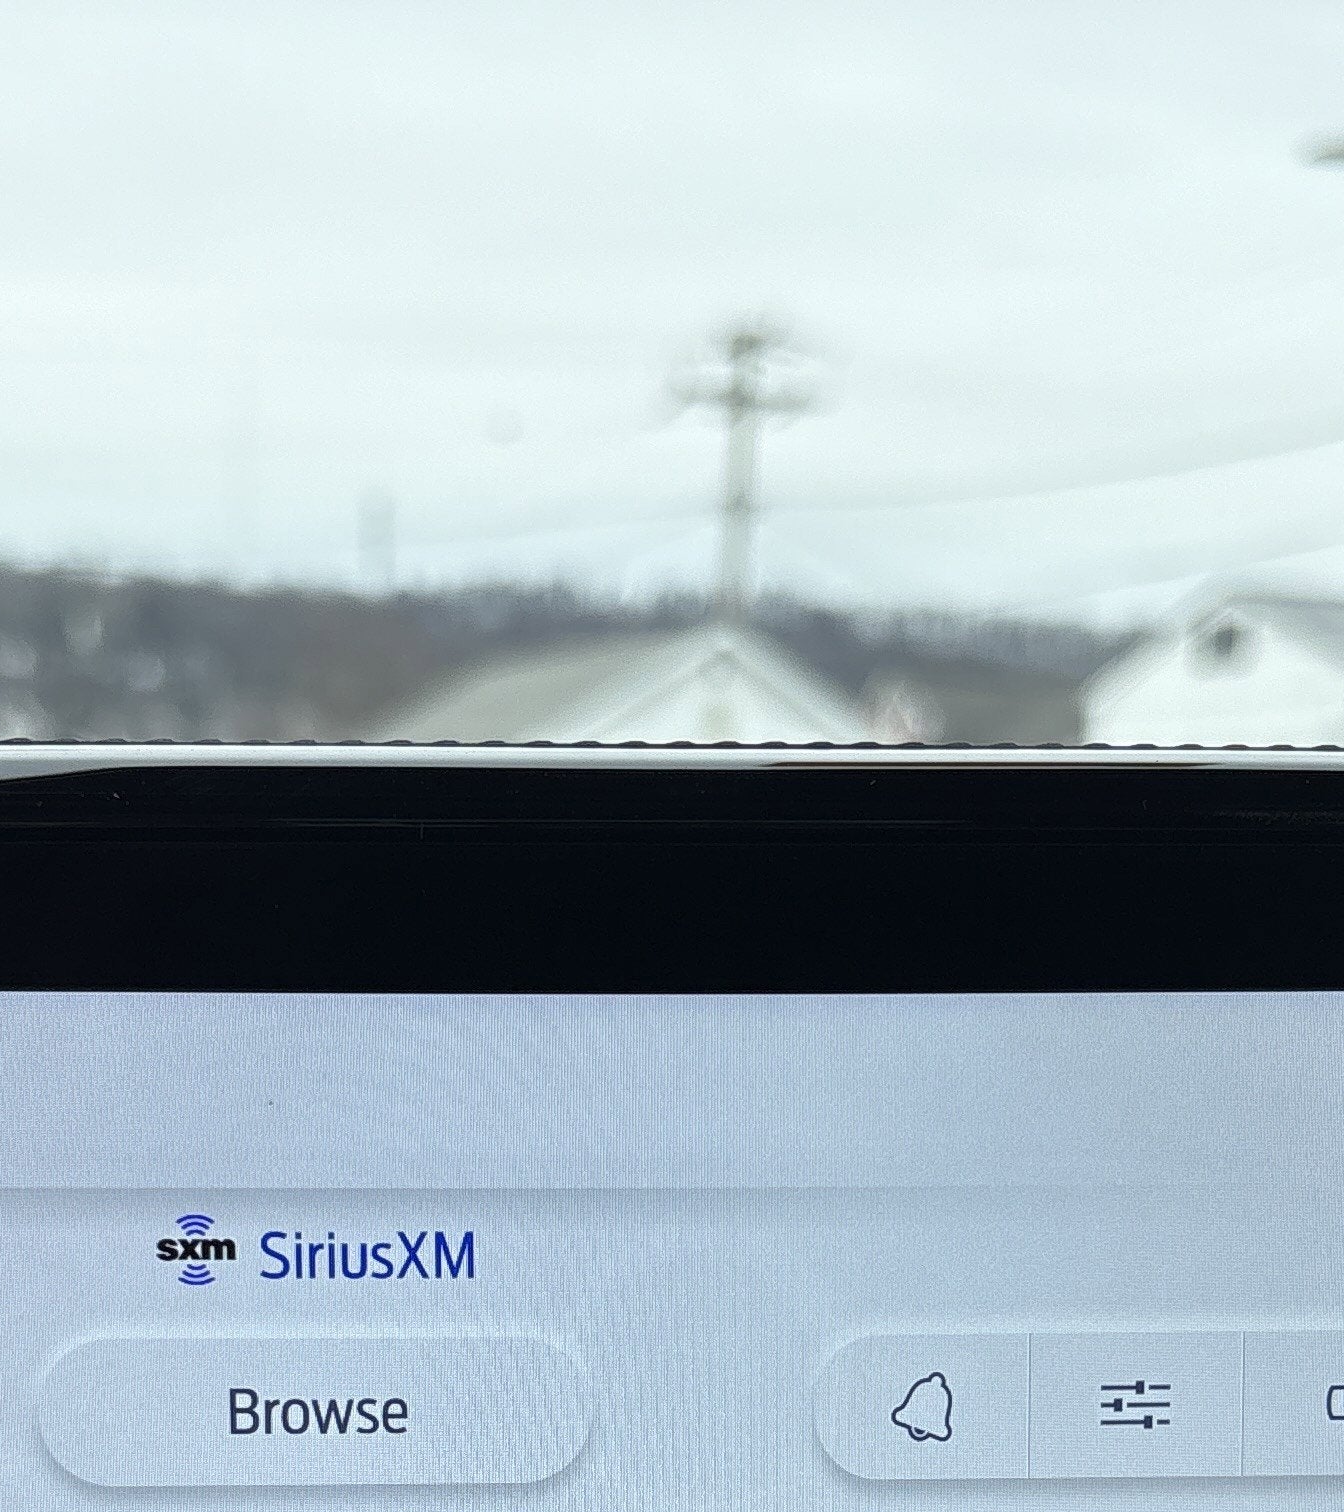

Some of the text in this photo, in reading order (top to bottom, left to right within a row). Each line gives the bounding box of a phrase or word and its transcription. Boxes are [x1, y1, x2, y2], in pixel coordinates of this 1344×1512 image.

[157, 1235, 236, 1262] sxm
[260, 1231, 475, 1280] SiriusXM
[229, 1388, 408, 1435] Browse
